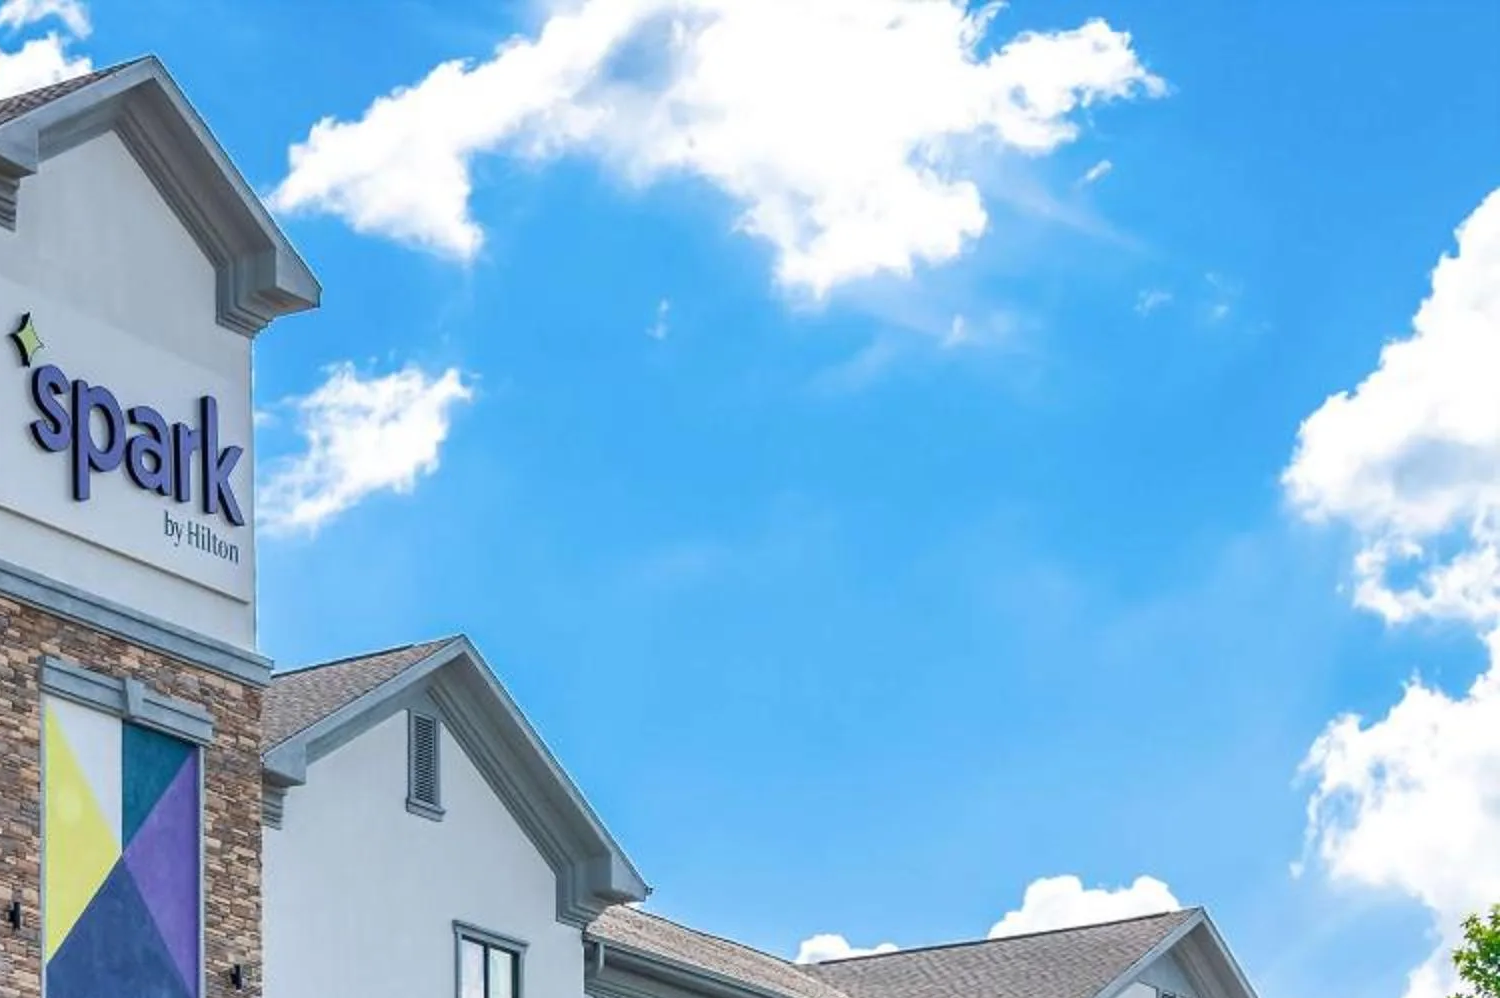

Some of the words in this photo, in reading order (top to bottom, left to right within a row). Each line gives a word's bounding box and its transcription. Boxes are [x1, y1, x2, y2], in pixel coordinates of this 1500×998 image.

[29, 363, 245, 527] spark
[163, 511, 185, 547] by
[186, 522, 240, 565] Hilton
